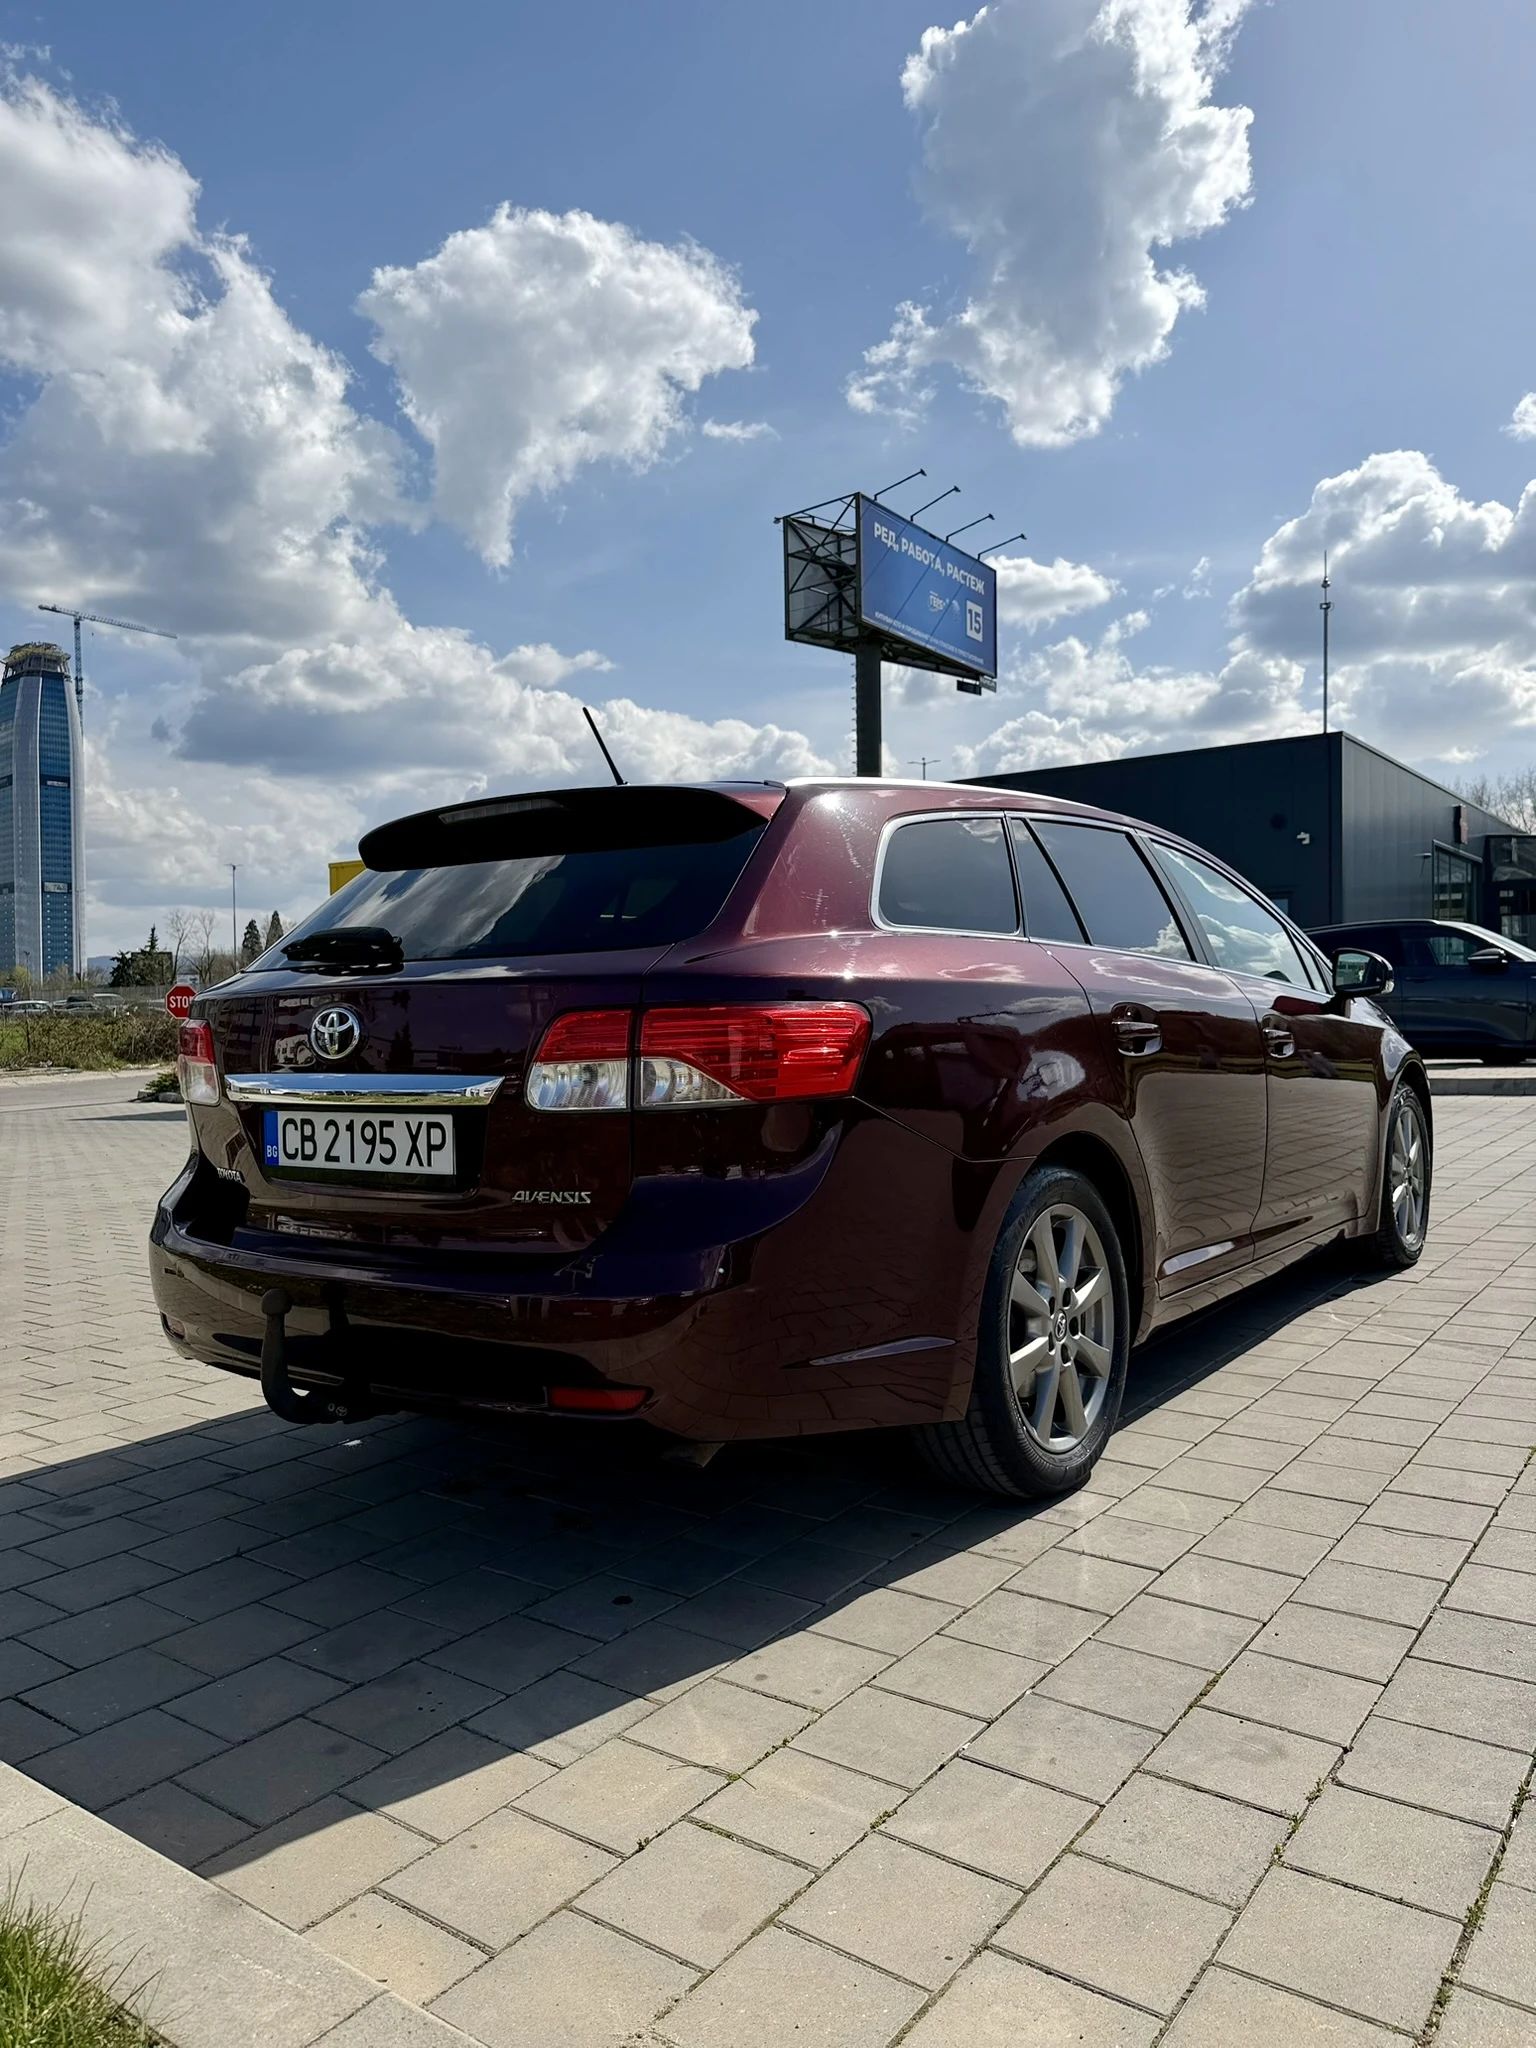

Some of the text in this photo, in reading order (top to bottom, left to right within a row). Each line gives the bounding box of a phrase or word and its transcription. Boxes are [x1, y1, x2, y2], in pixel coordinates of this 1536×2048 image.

[874, 522, 985, 595] РЕД, РАБОТА, РАСТЕЖ
[968, 608, 982, 634] 15
[266, 1144, 278, 1158] BG
[324, 1118, 397, 1166] 2195
[511, 1190, 592, 1204] AVENSIS
